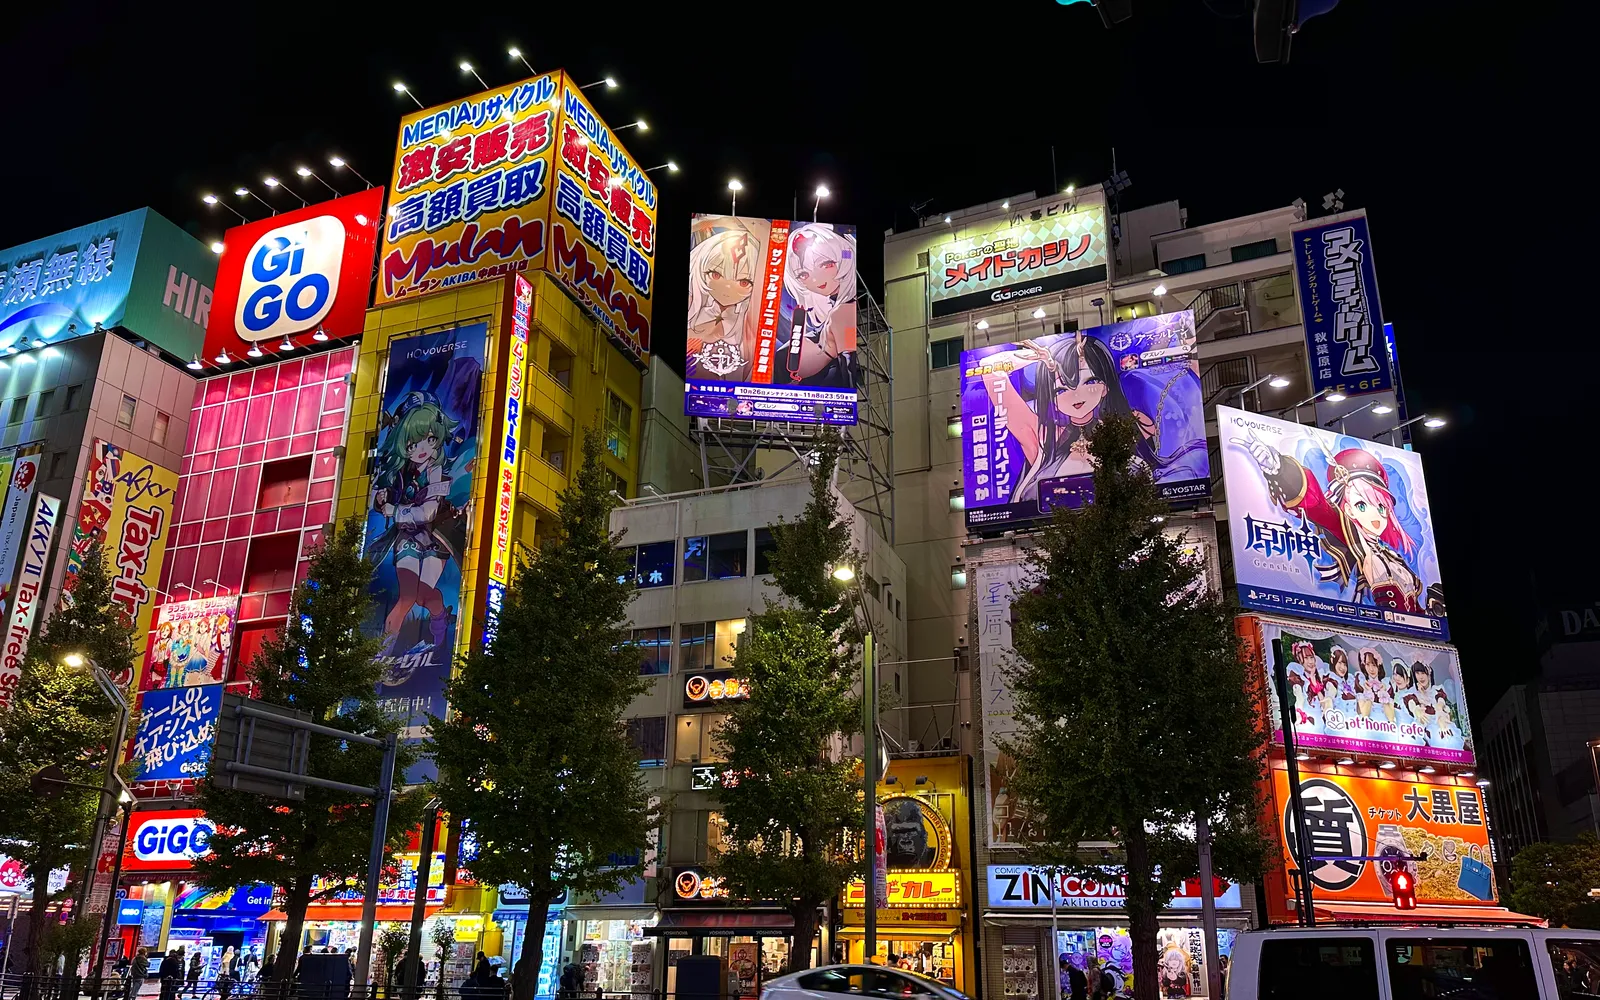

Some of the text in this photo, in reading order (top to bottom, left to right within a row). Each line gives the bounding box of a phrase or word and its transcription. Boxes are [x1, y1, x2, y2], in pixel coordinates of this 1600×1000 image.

[402, 75, 556, 149] MEDIAリサイクル
[397, 111, 551, 191] 激安販売
[565, 88, 656, 208] MEDIAリサイクル
[388, 160, 547, 244] 高額買取
[561, 122, 653, 252] 激安販売
[384, 216, 544, 297] Mulan
[557, 172, 651, 295] 高額買取
[944, 233, 1091, 289] メイドカジノ
[945, 237, 1019, 264] Pokerの聖地
[0, 238, 116, 306] 瀬無線
[395, 277, 441, 299] ムーラン
[441, 270, 477, 288] AKIBA
[552, 223, 650, 352] Mulan
[561, 272, 593, 308] ムーラン
[592, 302, 615, 331] AKIBA
[1304, 243, 1323, 318] トレーディングカードゲーム
[242, 273, 330, 332] GO
[406, 341, 468, 360] HOYOVERSE
[1314, 332, 1333, 380] 秋葉原店
[503, 396, 520, 465] AKIBA
[992, 378, 1011, 500] ゴールデン・ハインド
[1230, 417, 1283, 436] HOYOVERSE
[1172, 484, 1206, 495] YOSTAR
[29, 498, 54, 565] AKKY
[1243, 508, 1322, 584] 原神
[1253, 558, 1301, 574] Genshin
[5, 582, 40, 669] Tax-free
[1258, 591, 1335, 612] PS5 PS4 Windows
[1367, 806, 1402, 820] チケット
[1402, 786, 1483, 826] 大黒屋
[137, 824, 214, 856] GiGO
[247, 896, 265, 905] Get
[995, 871, 1052, 906] ZIN
